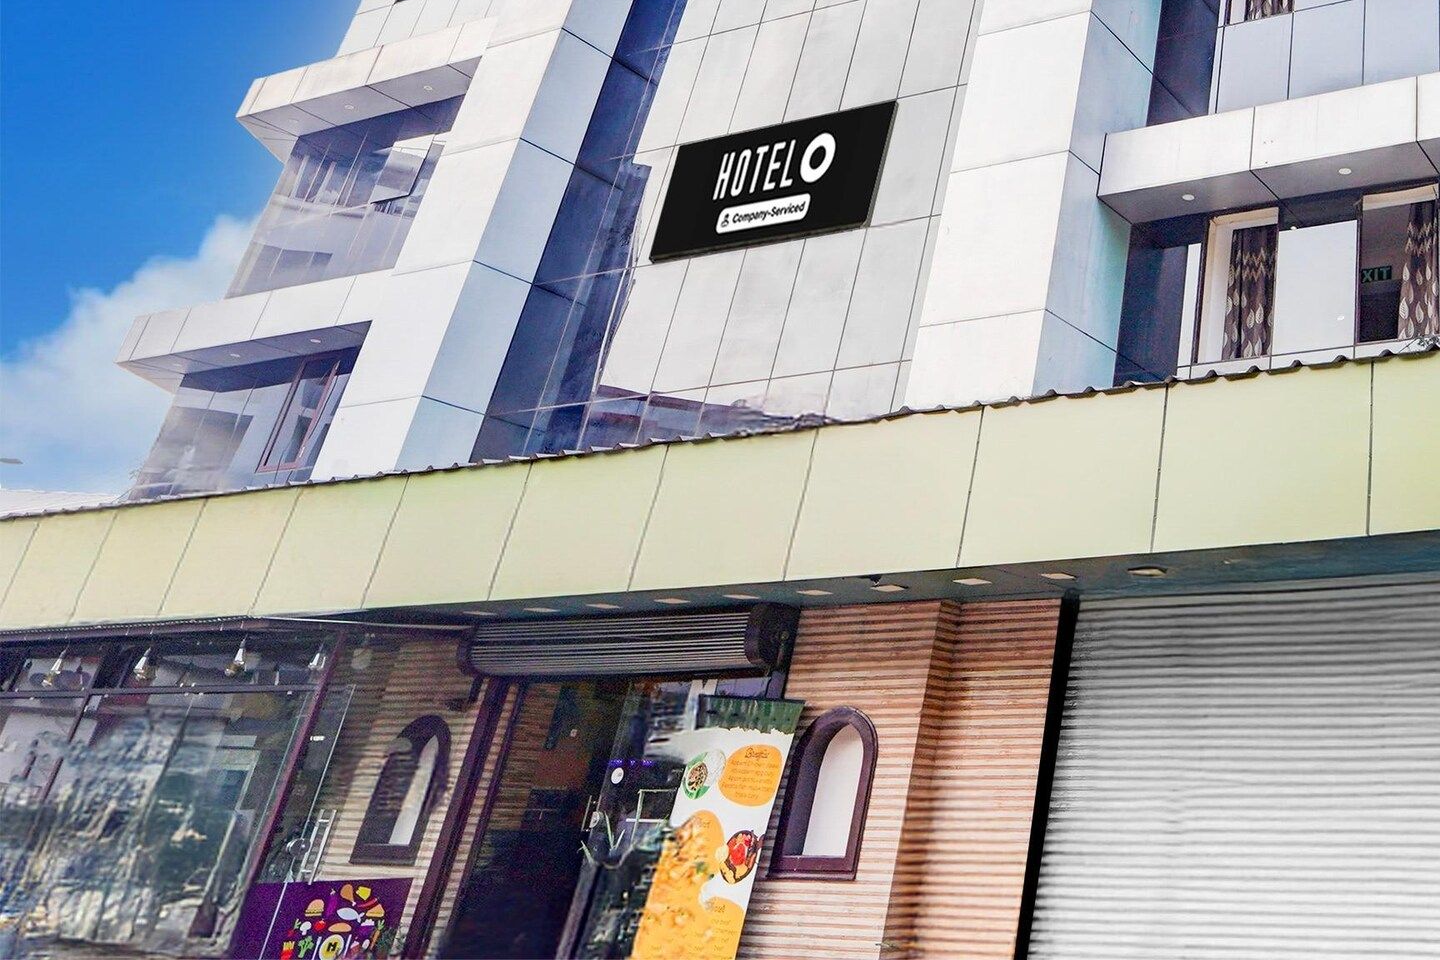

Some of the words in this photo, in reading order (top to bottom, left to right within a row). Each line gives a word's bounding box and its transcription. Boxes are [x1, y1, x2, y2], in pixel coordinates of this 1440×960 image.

[712, 139, 796, 201] HOTEL
[799, 132, 837, 184] O
[731, 200, 807, 224] Company-Serviced
[1361, 267, 1391, 283] XIT
